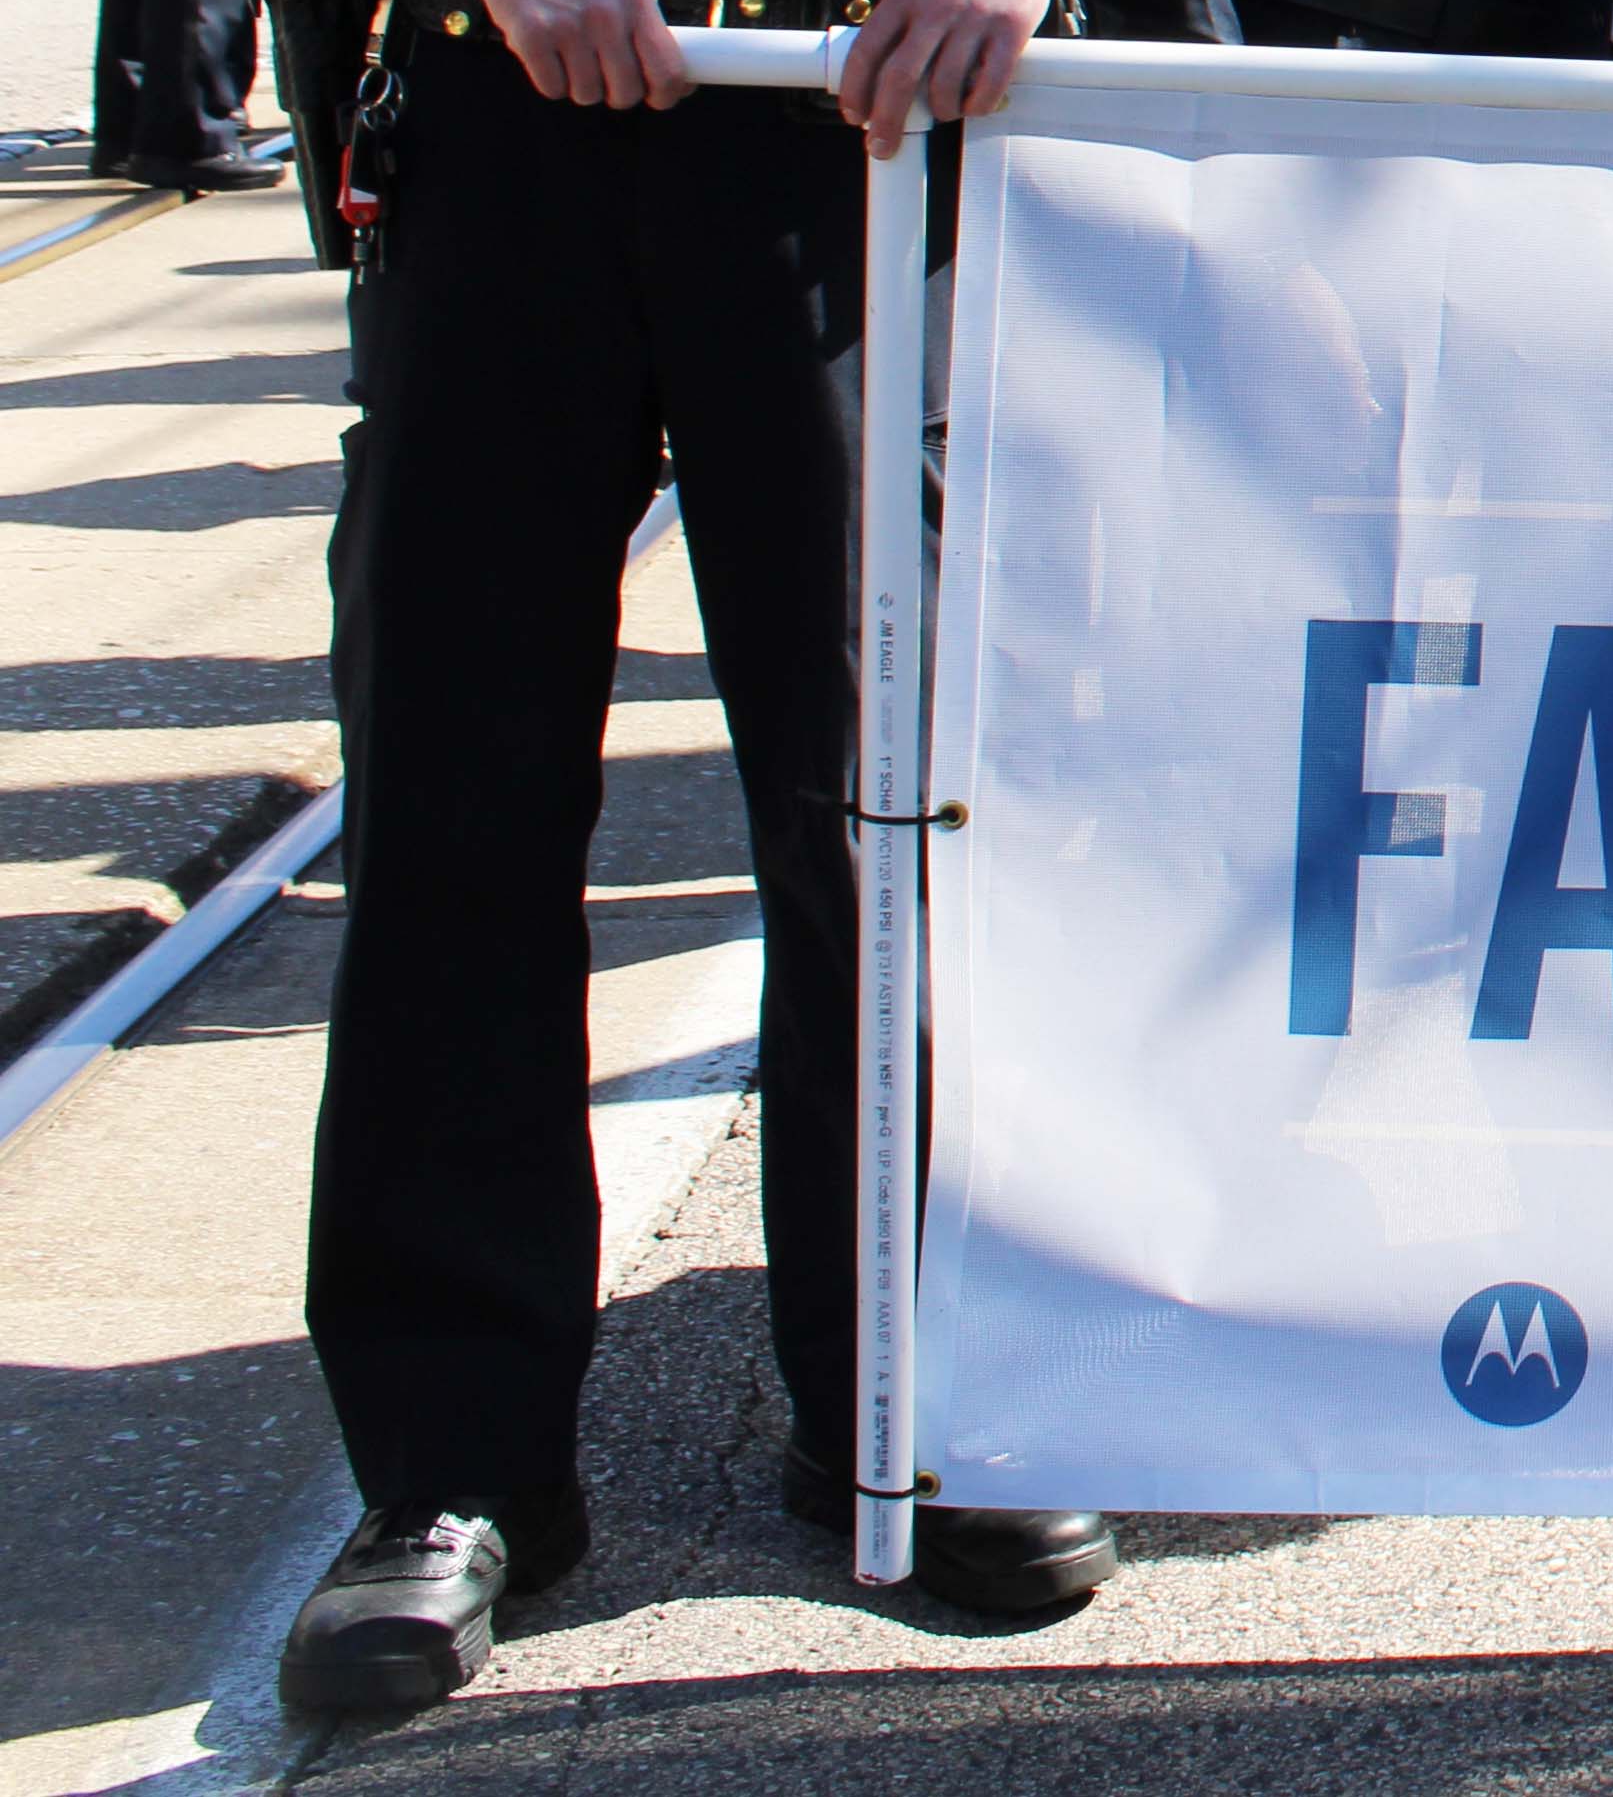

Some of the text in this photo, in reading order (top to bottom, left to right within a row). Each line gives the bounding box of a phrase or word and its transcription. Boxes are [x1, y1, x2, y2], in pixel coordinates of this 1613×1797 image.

[880, 619, 894, 637] JM
[880, 640, 894, 683] EAGLE
[880, 772, 893, 812] SCH40
[879, 827, 893, 881] PVC1120
[879, 887, 893, 909] 450
[879, 911, 893, 931] PSI
[879, 1064, 892, 1090] NSF
